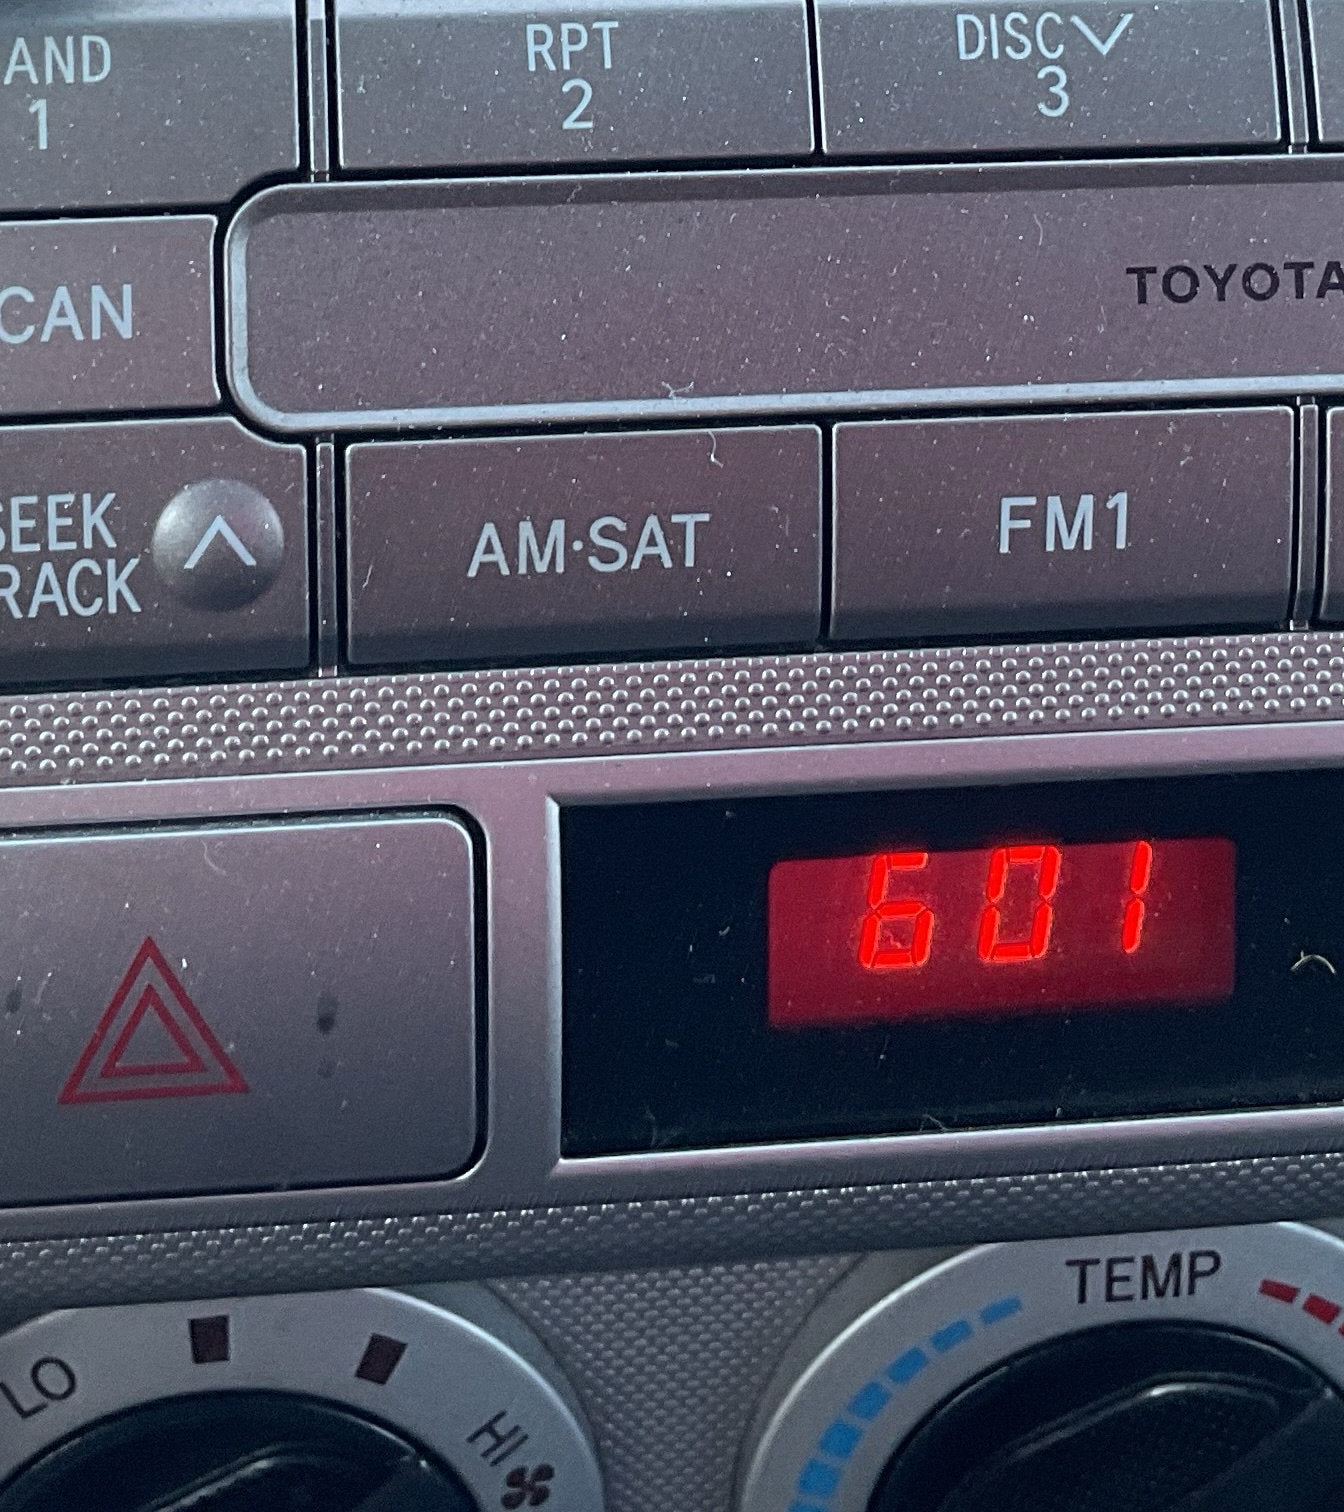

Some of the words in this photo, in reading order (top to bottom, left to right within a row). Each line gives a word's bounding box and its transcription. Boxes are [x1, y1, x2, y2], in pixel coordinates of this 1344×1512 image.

[526, 21, 619, 72] RPT
[957, 13, 1065, 62] DISC
[561, 79, 594, 131] 2
[1038, 67, 1070, 119] 3
[28, 99, 50, 151] 1
[999, 492, 1130, 554] FM1
[1065, 1249, 1222, 1305] TEMP
[467, 1410, 531, 1467] HI
